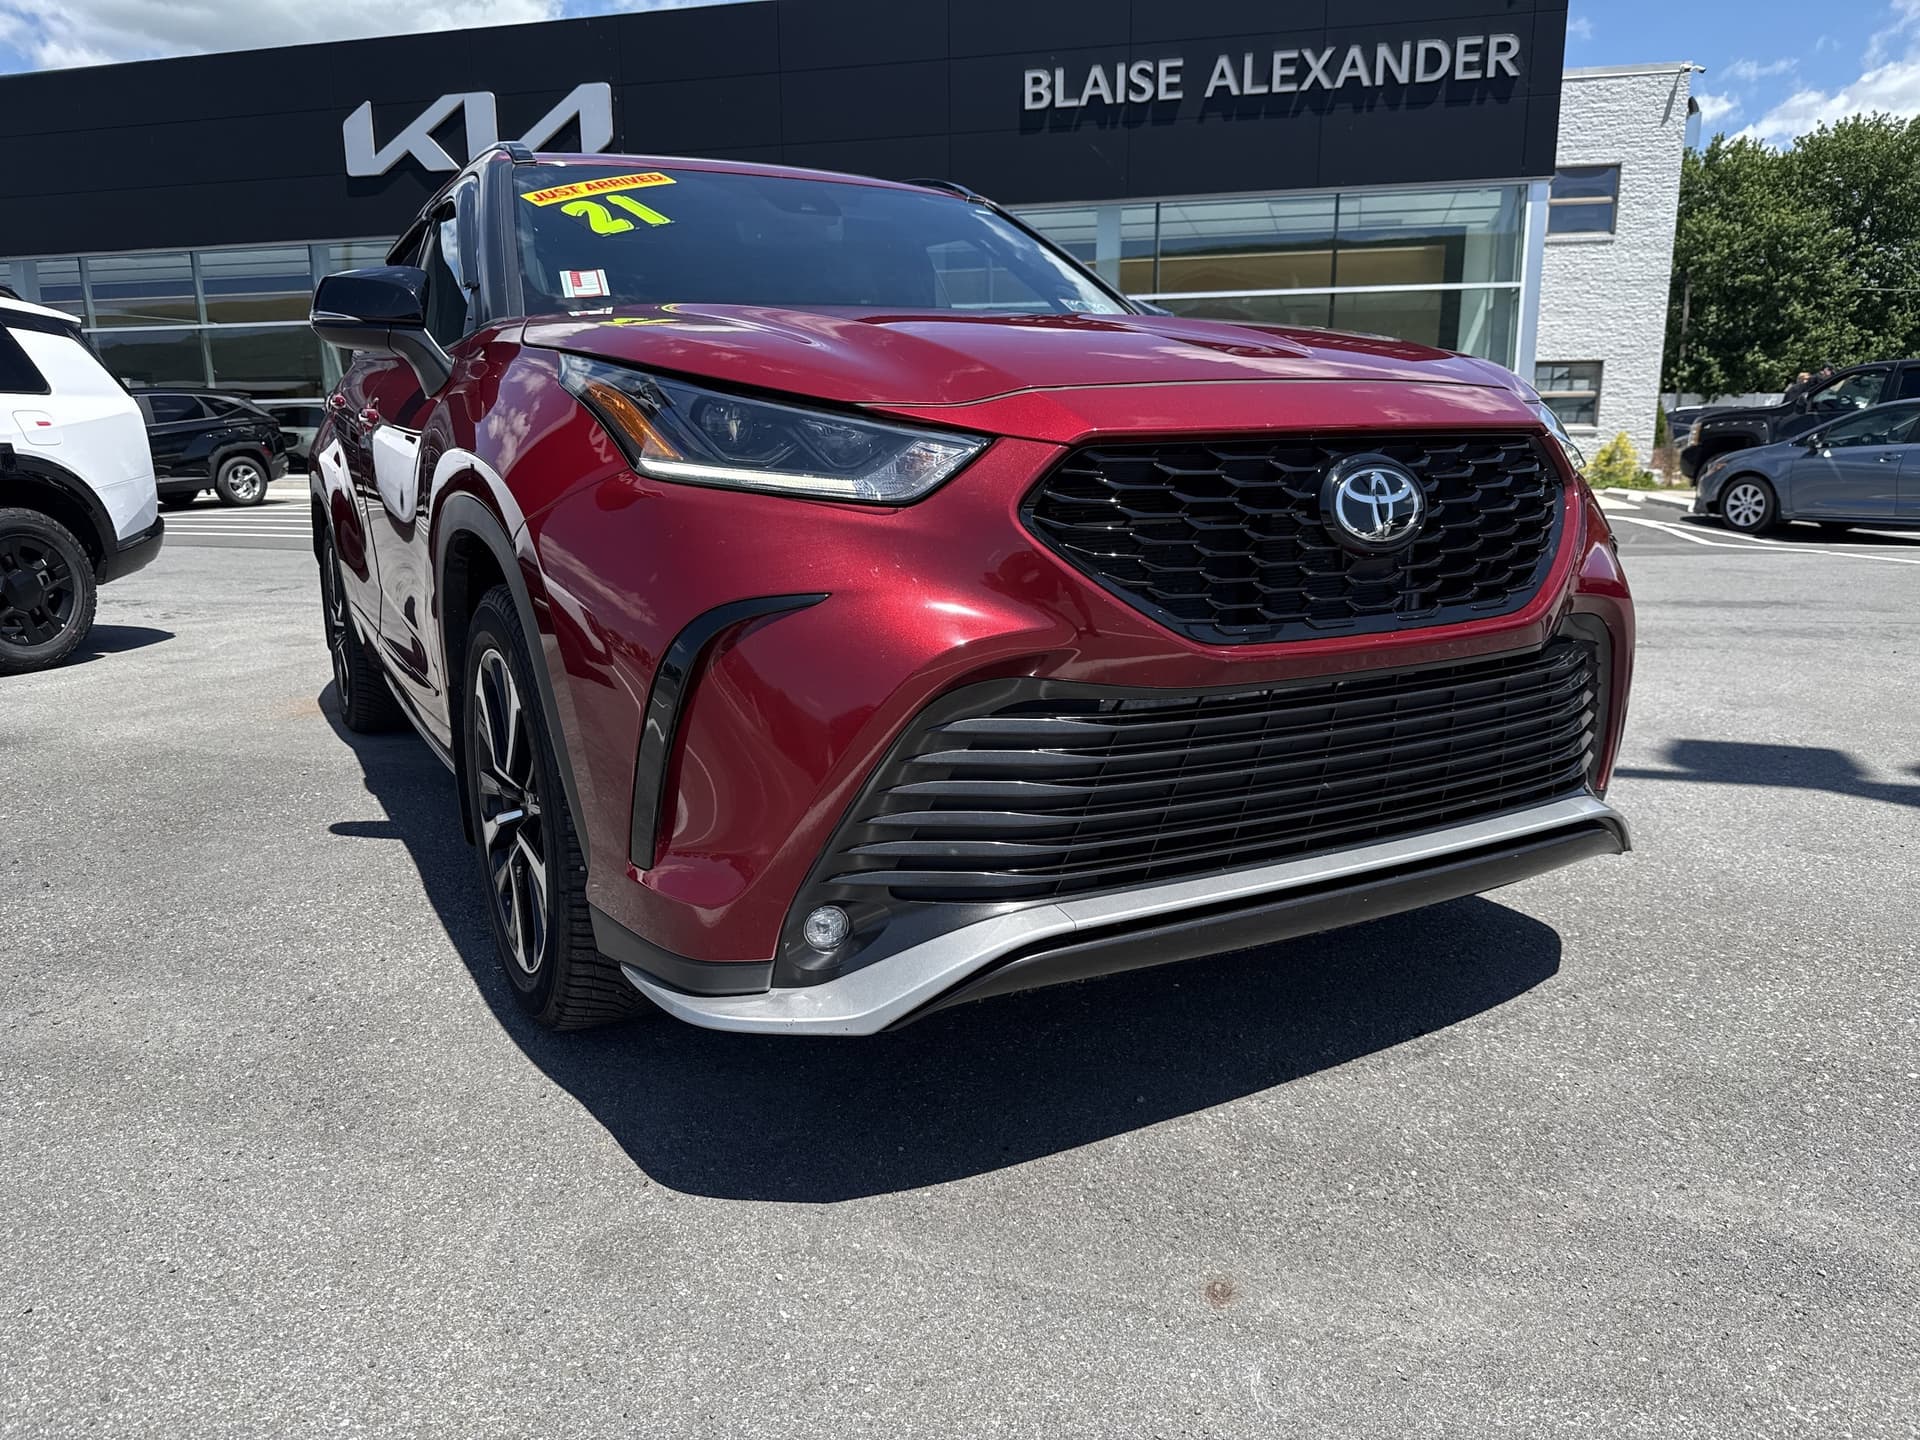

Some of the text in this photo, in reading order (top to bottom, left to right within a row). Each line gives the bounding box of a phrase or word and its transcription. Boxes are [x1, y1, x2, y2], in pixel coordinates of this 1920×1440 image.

[1023, 33, 1521, 110] BLAISE ALEXANDER
[533, 173, 664, 202] JUST ARRIVED
[560, 194, 671, 235] 21
